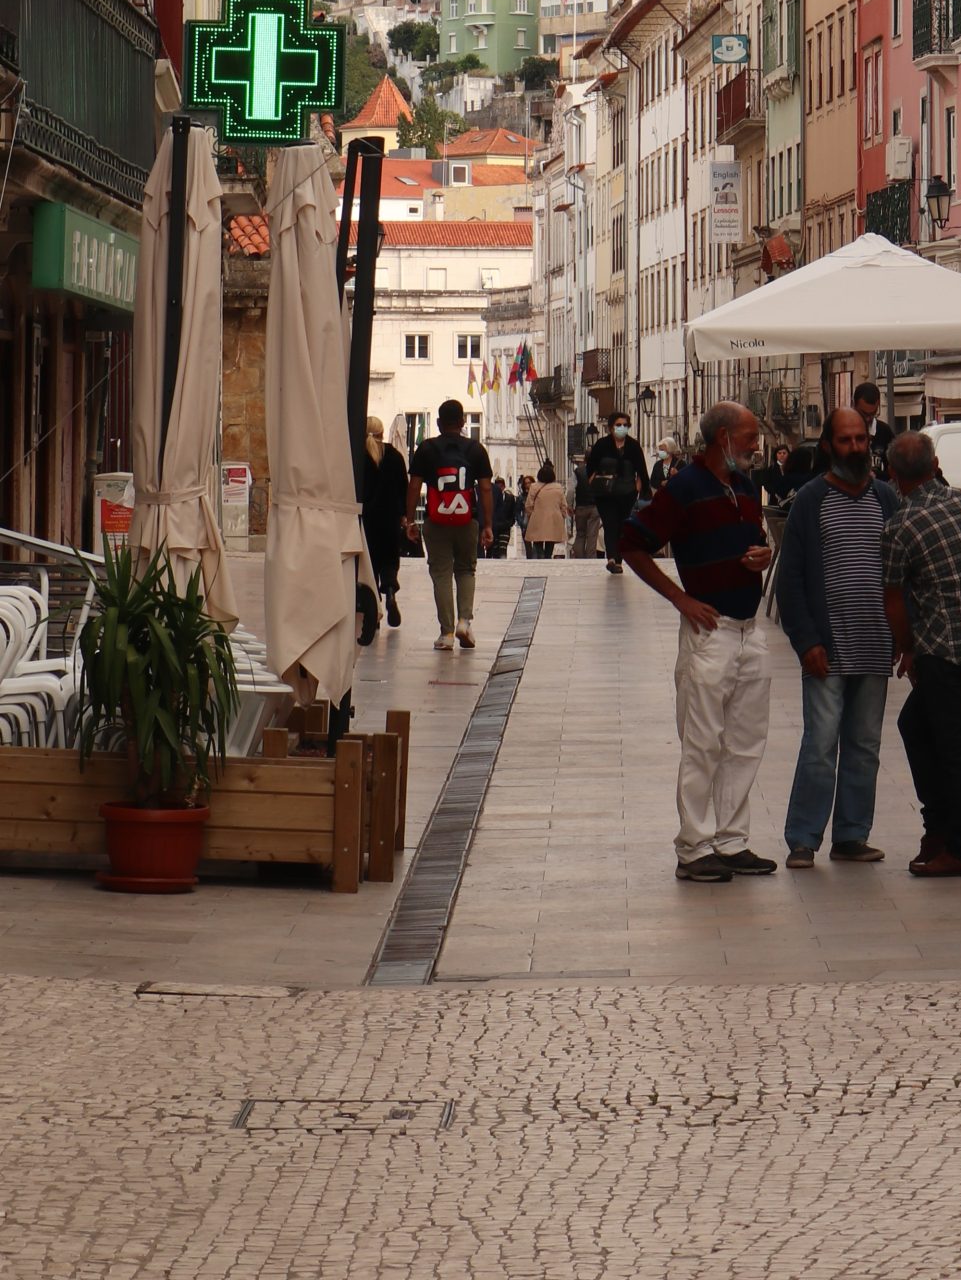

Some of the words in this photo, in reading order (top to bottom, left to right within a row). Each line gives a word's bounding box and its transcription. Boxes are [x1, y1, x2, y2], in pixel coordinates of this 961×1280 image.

[713, 170, 739, 180] English
[71, 230, 135, 303] FARMÁCIA
[729, 338, 766, 351] Nicola
